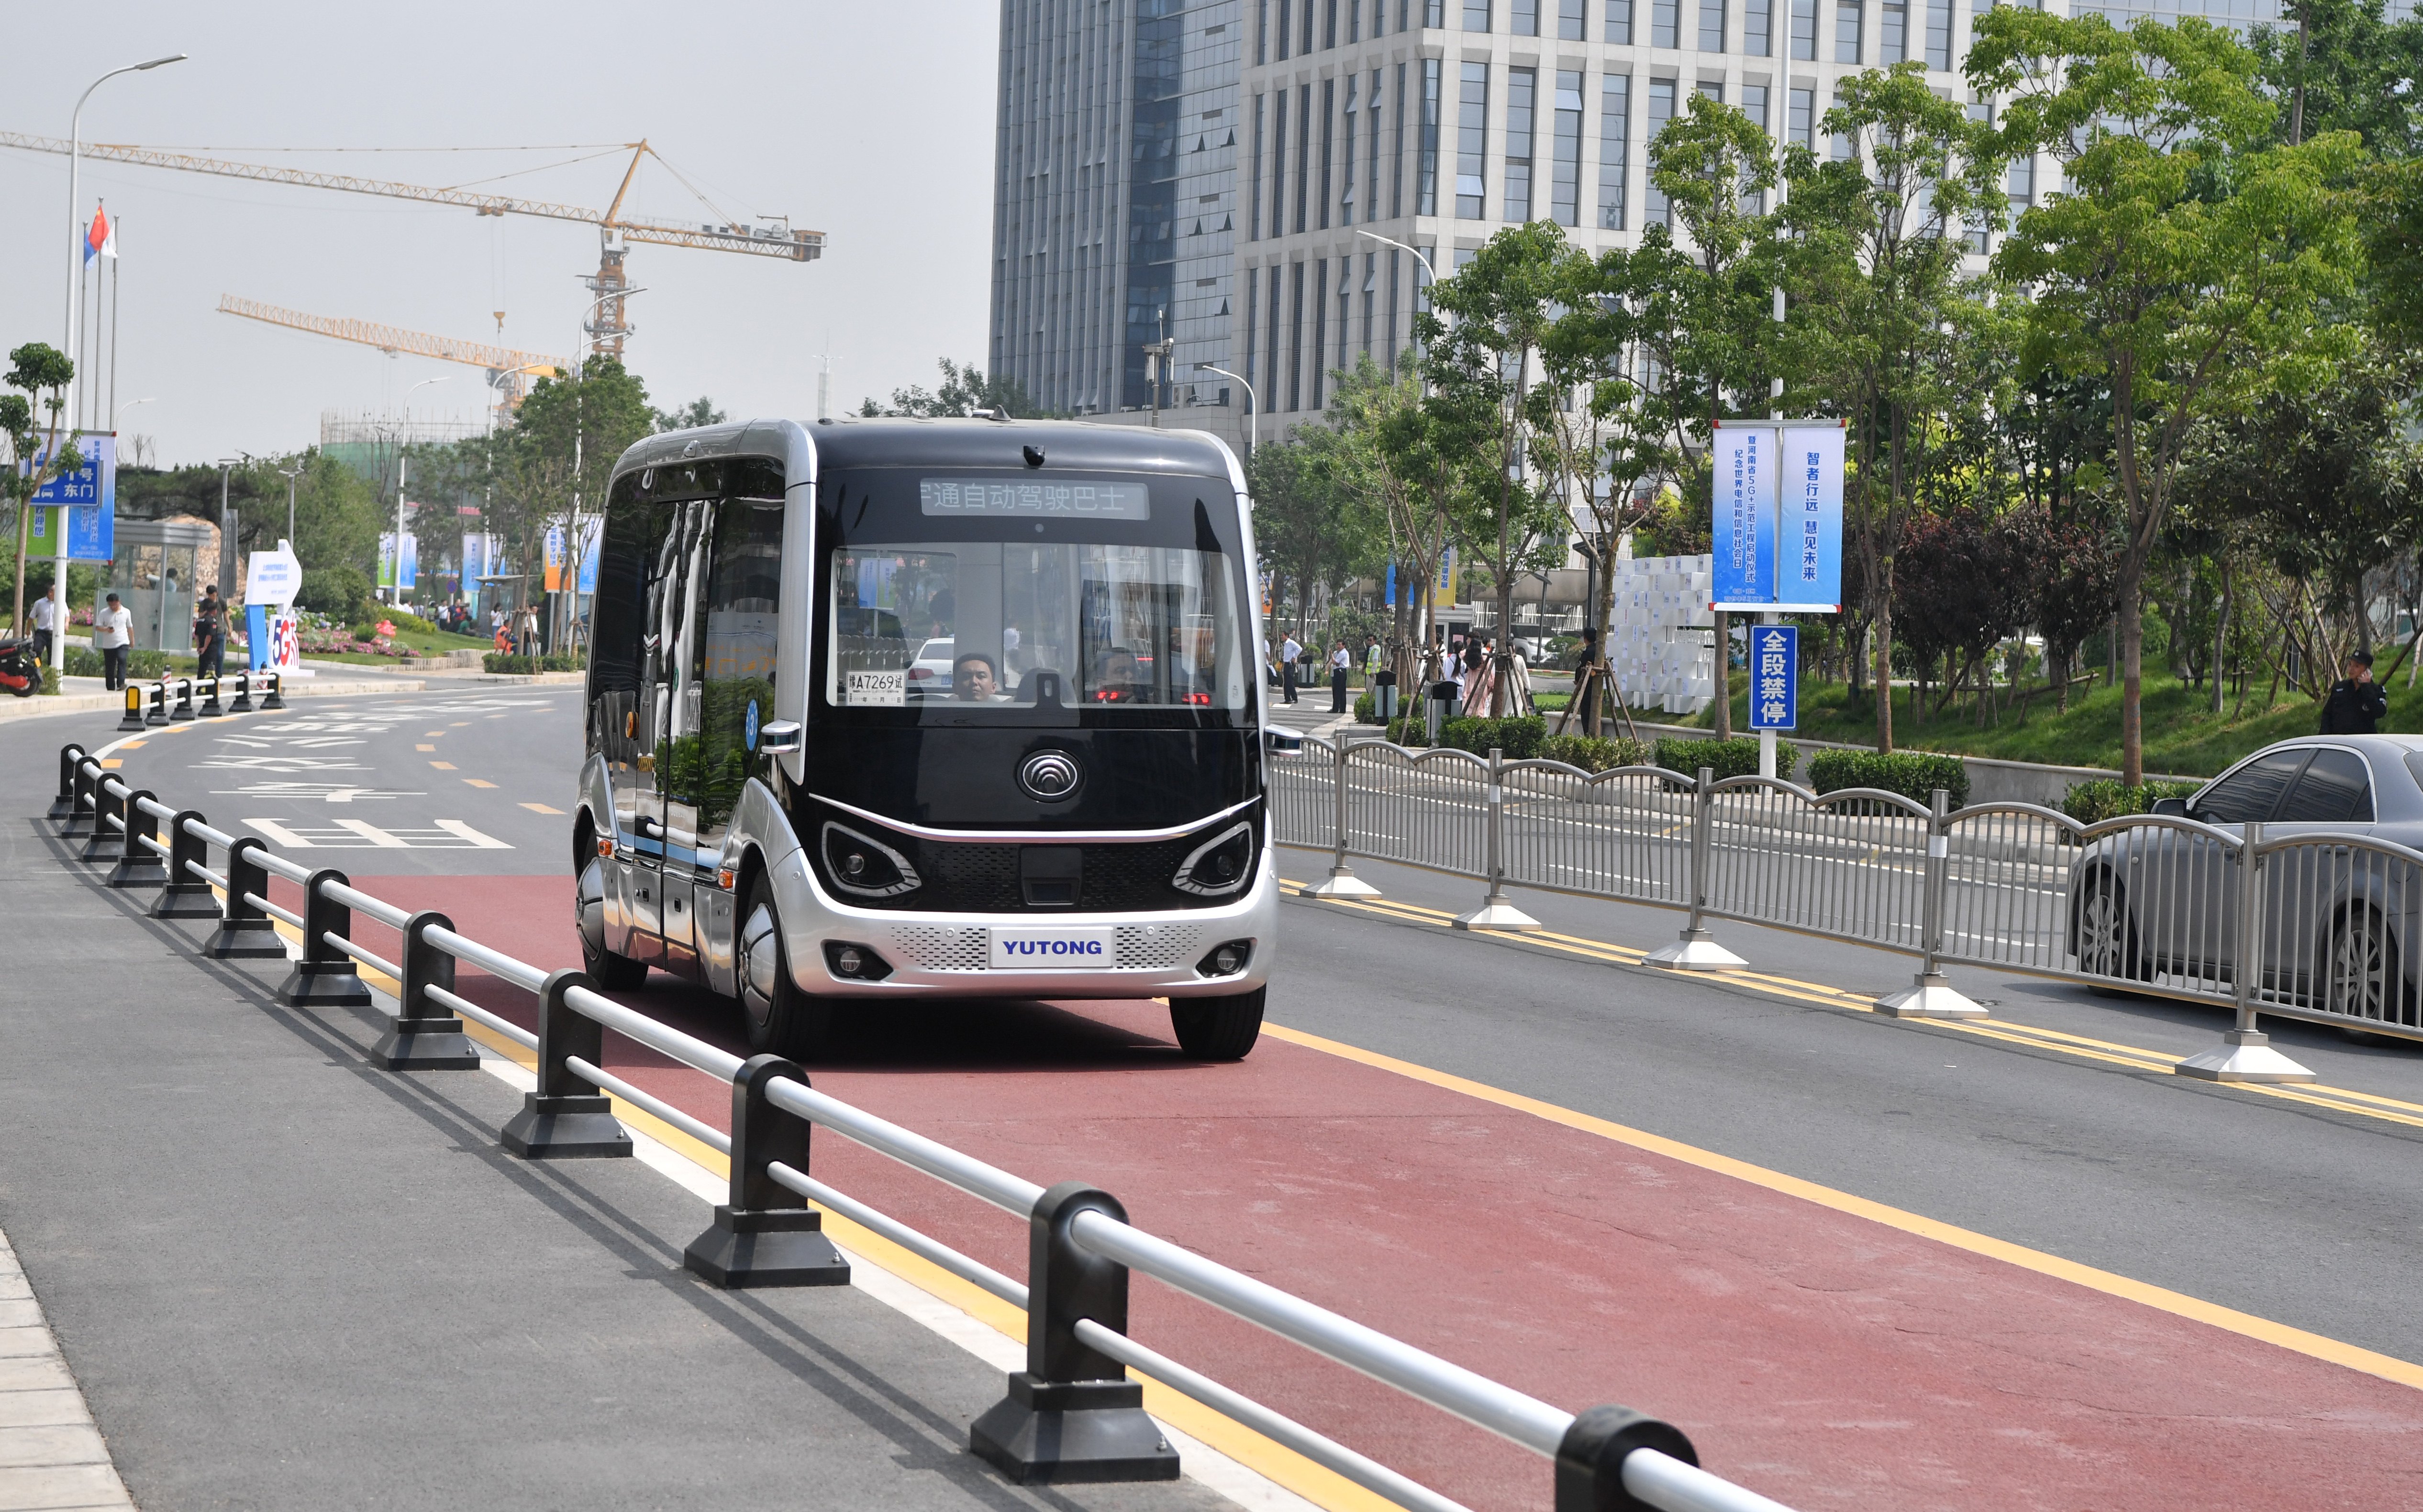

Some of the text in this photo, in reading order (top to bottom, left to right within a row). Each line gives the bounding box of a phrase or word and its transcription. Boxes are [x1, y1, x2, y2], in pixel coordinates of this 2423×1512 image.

[64, 484, 93, 498] 东门
[1734, 449, 1744, 568] 纪念世界电信和信息社会日
[1745, 436, 1756, 582] 暨河南省5G+示范工程启动仪式
[1802, 452, 1820, 581] 智者行远 慧见未来
[1761, 630, 1787, 723] 全段禁停
[1002, 941, 1102, 955] YUTONG
